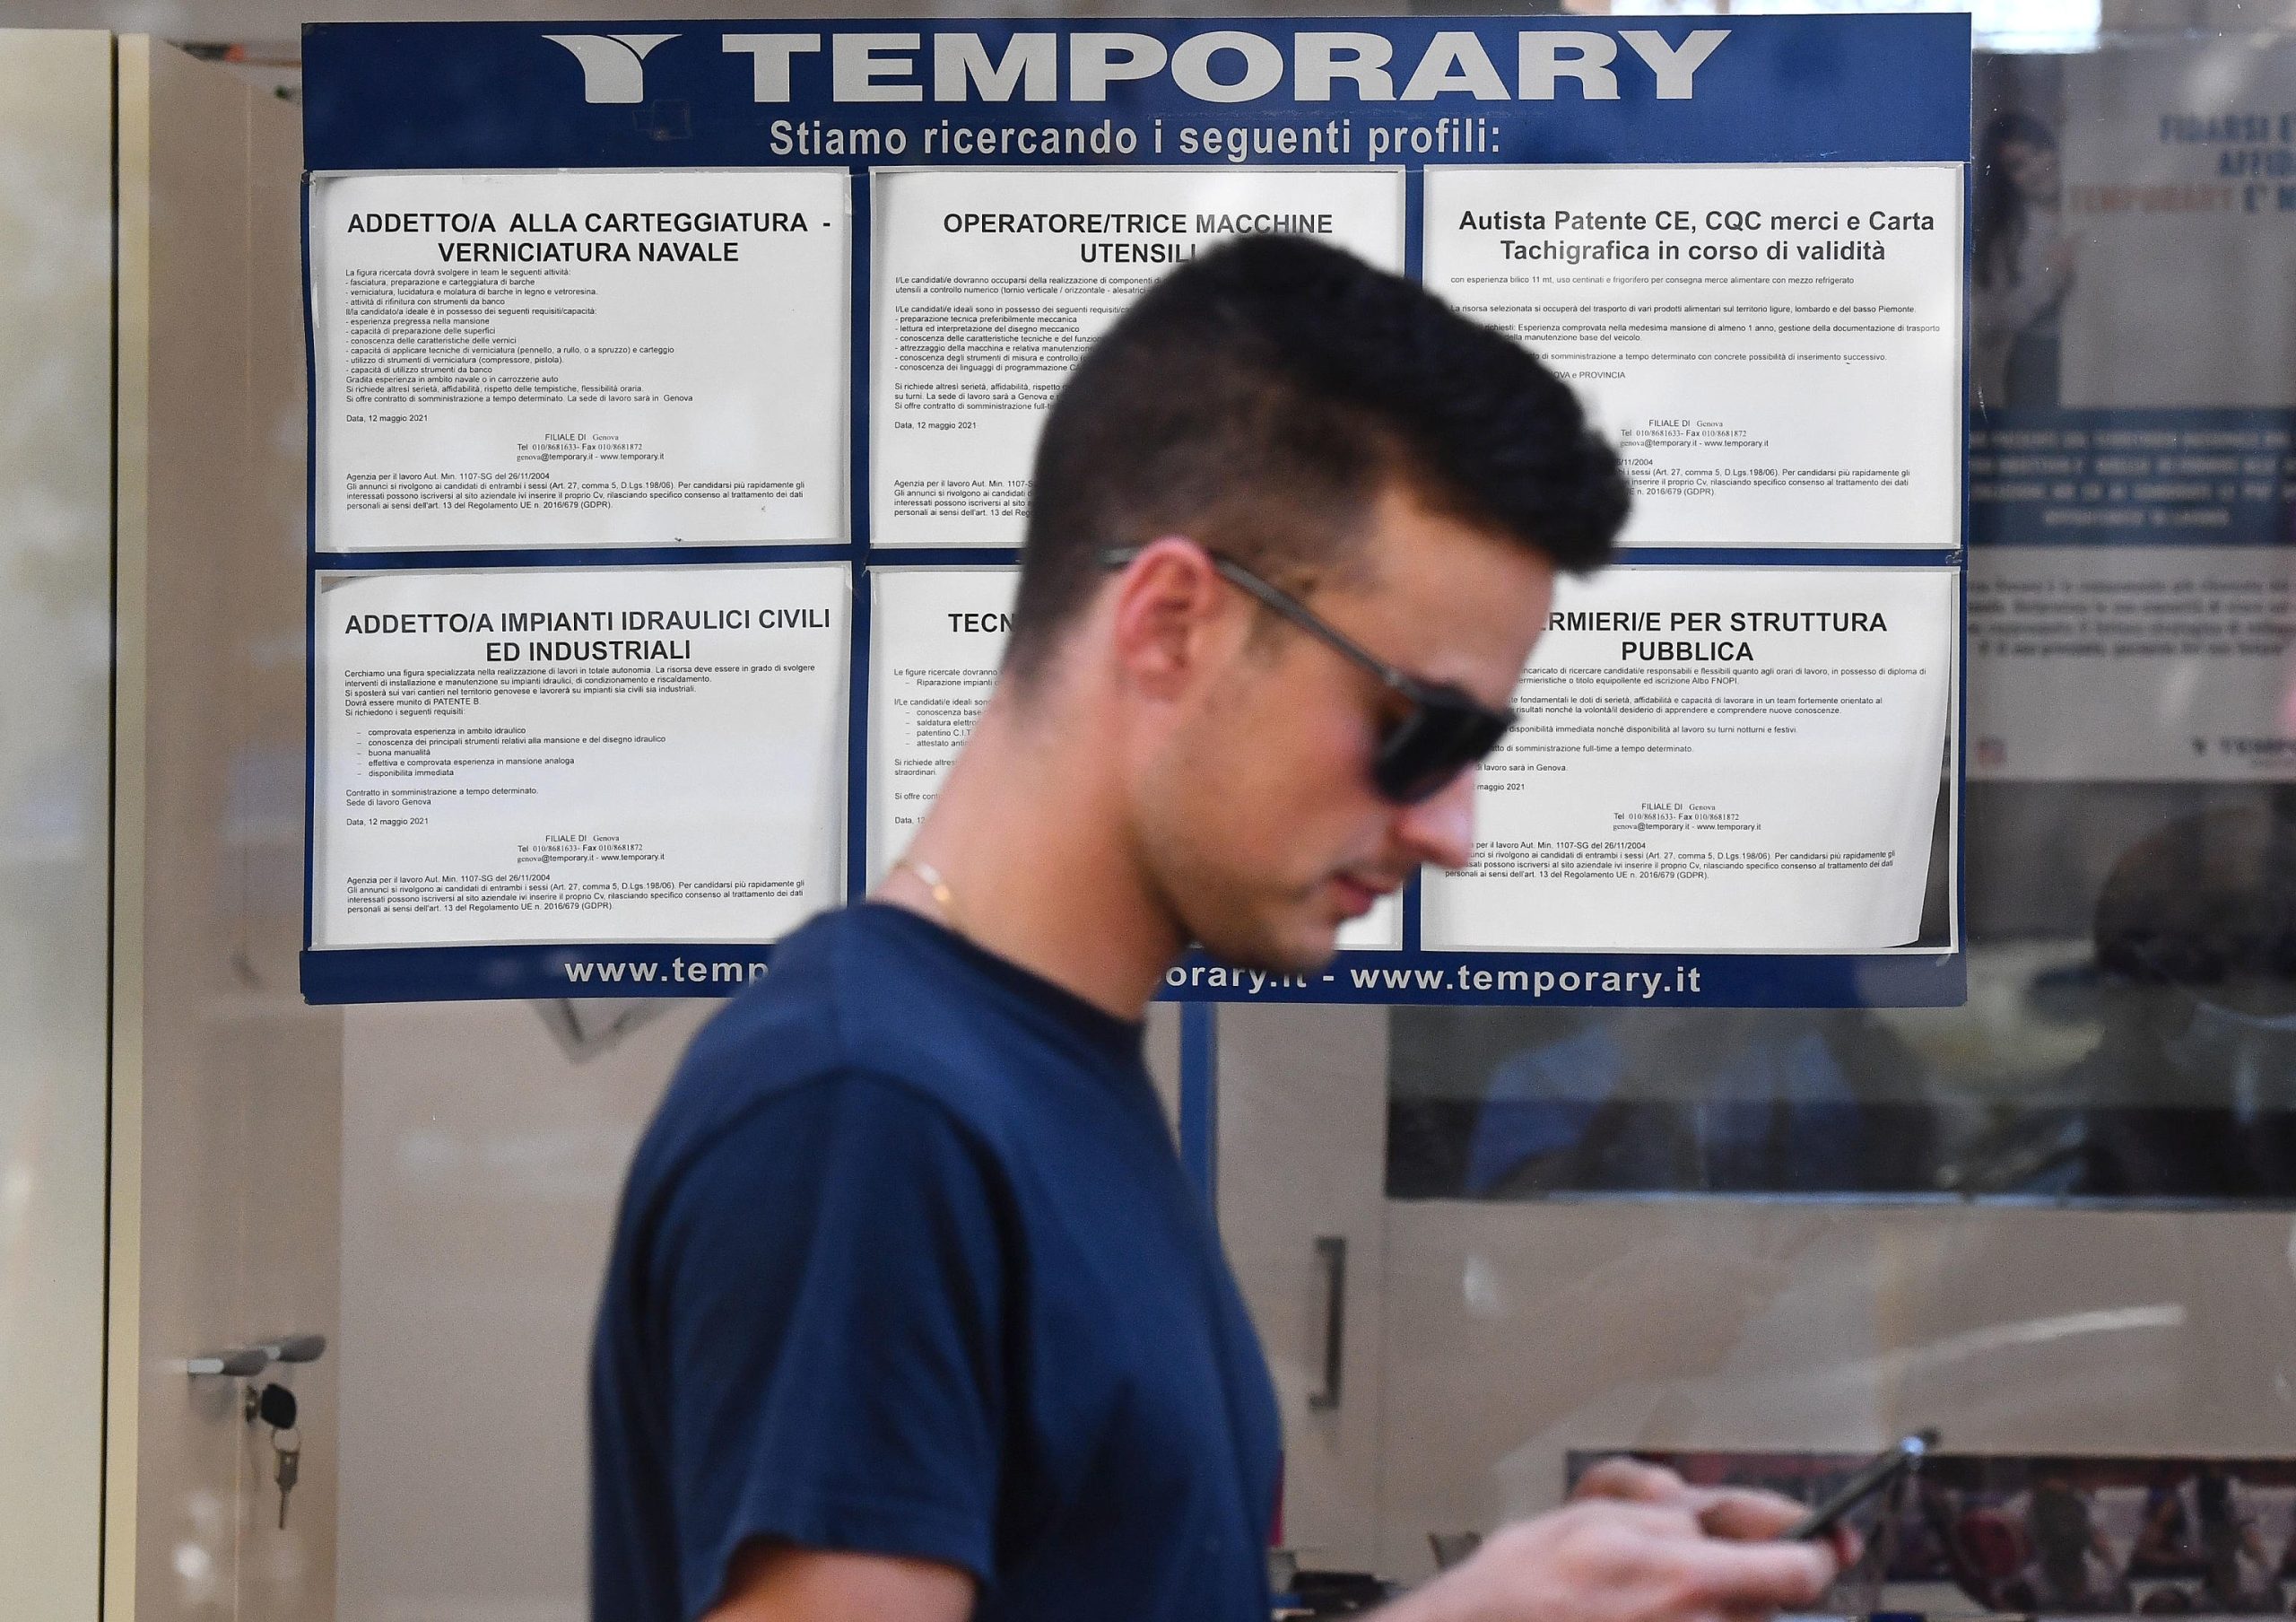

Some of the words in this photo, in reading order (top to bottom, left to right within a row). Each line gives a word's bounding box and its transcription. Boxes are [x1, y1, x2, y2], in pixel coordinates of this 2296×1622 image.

[721, 30, 1731, 102] TEMPORARY
[770, 119, 906, 154] Stiamo
[925, 118, 1136, 153] ricercando
[1155, 128, 1161, 153] i
[1179, 118, 1349, 162] seguenti
[1369, 118, 1498, 161] profili:
[347, 213, 496, 232] ADDETTO/A
[509, 213, 578, 232] ALLA
[585, 212, 807, 232] CARTEGGIATURA
[944, 214, 1187, 233] OPERATORE/TRICE
[1196, 214, 1332, 233] MACCHINE
[1458, 210, 1544, 230] Autista
[1555, 210, 1646, 230] Patente
[1655, 210, 1695, 233] CE,
[1706, 210, 1761, 231] CQC
[1770, 211, 1838, 231] merci
[1847, 215, 1860, 231] e
[1869, 210, 1934, 231] Carta
[438, 242, 631, 262] VERNICIATURA
[639, 242, 738, 262] NAVALE
[1500, 240, 1648, 265] Tachigrafica
[1658, 240, 1679, 259] in
[1688, 245, 1758, 260] corso
[1766, 240, 1787, 260] di
[1796, 240, 1884, 260] validità
[356, 268, 377, 277] figura
[378, 268, 411, 276] ricercata
[437, 268, 469, 277] svolgere
[509, 268, 542, 277] seguenti
[900, 316, 948, 324] preparazione
[979, 315, 1035, 324] preferibilmente
[375, 375, 416, 384] esperienza
[346, 414, 365, 423] Data,
[378, 414, 407, 423] maggio
[409, 414, 427, 422] 2021
[1648, 419, 1679, 427] FILIALE
[1682, 419, 1690, 427] DI
[894, 421, 914, 429] Data,
[917, 421, 926, 429] 12
[927, 422, 955, 431] maggio
[958, 421, 976, 429] 2021
[544, 432, 575, 440] FILIALE
[1685, 429, 1700, 437] Fax
[517, 443, 527, 451] Tel
[581, 442, 596, 450] Fax
[1620, 439, 1697, 449] genova@temporary.it
[1703, 440, 1769, 449] www.temporary.it
[516, 452, 593, 462] genova@temporary.it
[599, 452, 664, 461] www.temporary.it
[344, 613, 493, 634] ADDETTO/A
[501, 611, 613, 632] IMPIANTI
[622, 609, 749, 631] IDRAULICI
[759, 608, 829, 629] CIVILI
[947, 614, 1013, 633] TECN
[1548, 612, 1661, 632] RMIERI/E
[1670, 612, 1721, 632] PER
[1730, 612, 1887, 632] STRUTTURA
[486, 641, 519, 661] ED
[529, 640, 690, 661] INDUSTRIALI
[1622, 641, 1753, 661] PUBBLICA
[905, 668, 926, 677] figure
[433, 697, 470, 705] PATENTE
[354, 708, 393, 716] richiedono
[399, 708, 431, 717] seguenti
[401, 798, 430, 806] Genova
[1641, 802, 1672, 810] FILIALE
[1689, 803, 1715, 811] Genova
[1613, 812, 1624, 820] Tel
[1678, 812, 1692, 820] Fax
[346, 818, 366, 826] Data,
[369, 817, 378, 825] 12
[379, 817, 407, 827] maggio
[1613, 822, 1689, 832] genova@temporary.it
[1696, 823, 1761, 832] www.temporary.it
[545, 834, 576, 842] FILIALE
[517, 844, 528, 852] Tel
[582, 843, 596, 851] Fax
[598, 843, 642, 851] 010/8681872
[517, 853, 594, 864] genova@temporary.it
[600, 853, 665, 862] www.temporary.it
[564, 956, 769, 986] www.temp
[1350, 963, 1700, 999] www.temporary.it
